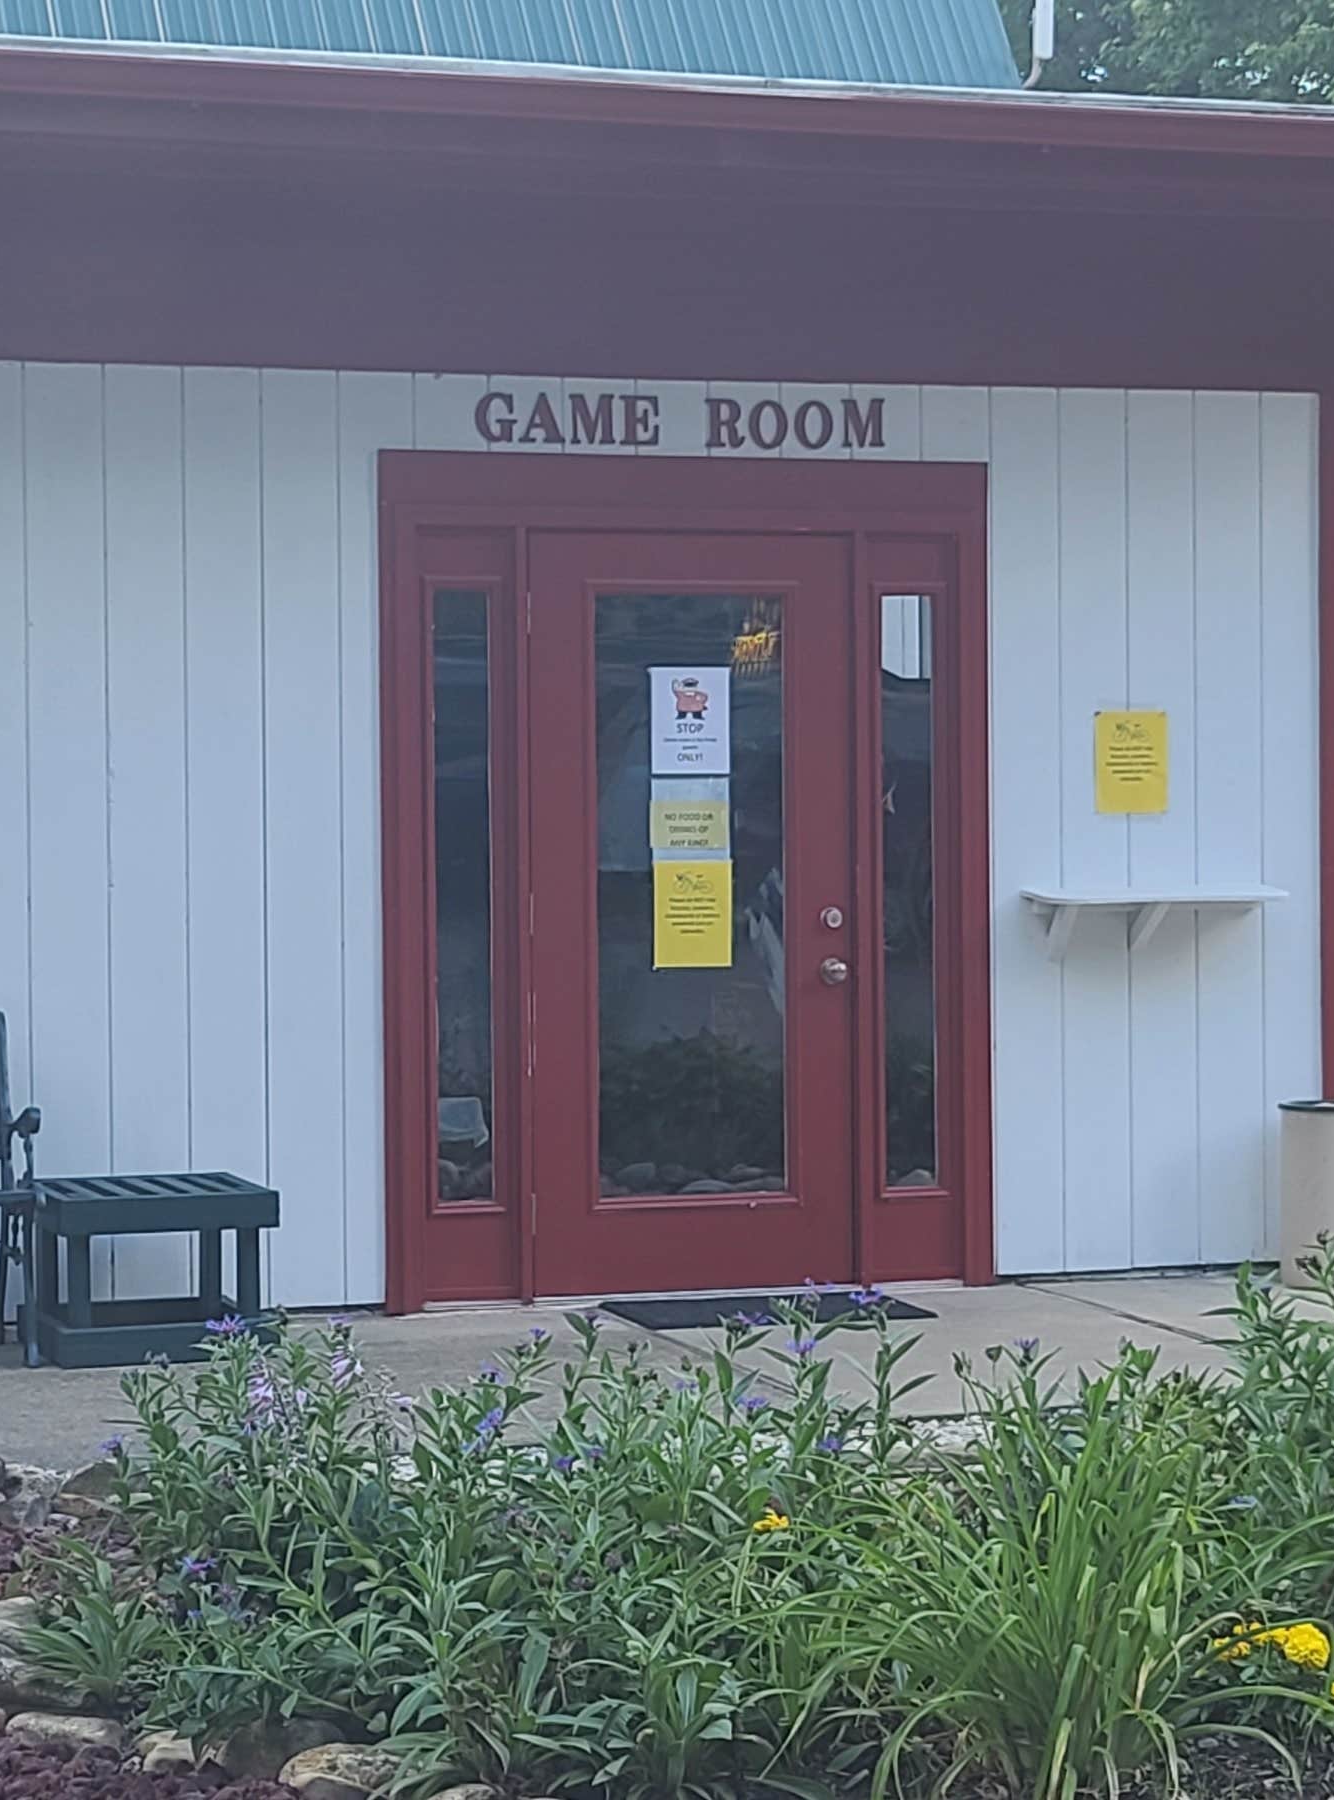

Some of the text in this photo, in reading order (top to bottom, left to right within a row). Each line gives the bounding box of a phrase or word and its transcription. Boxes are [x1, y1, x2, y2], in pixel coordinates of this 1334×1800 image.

[474, 391, 886, 449] GAME ROOM
[676, 723, 705, 734] STOP
[676, 752, 704, 762] ONLY!
[664, 812, 677, 821] NO
[678, 812, 701, 821] FOOD
